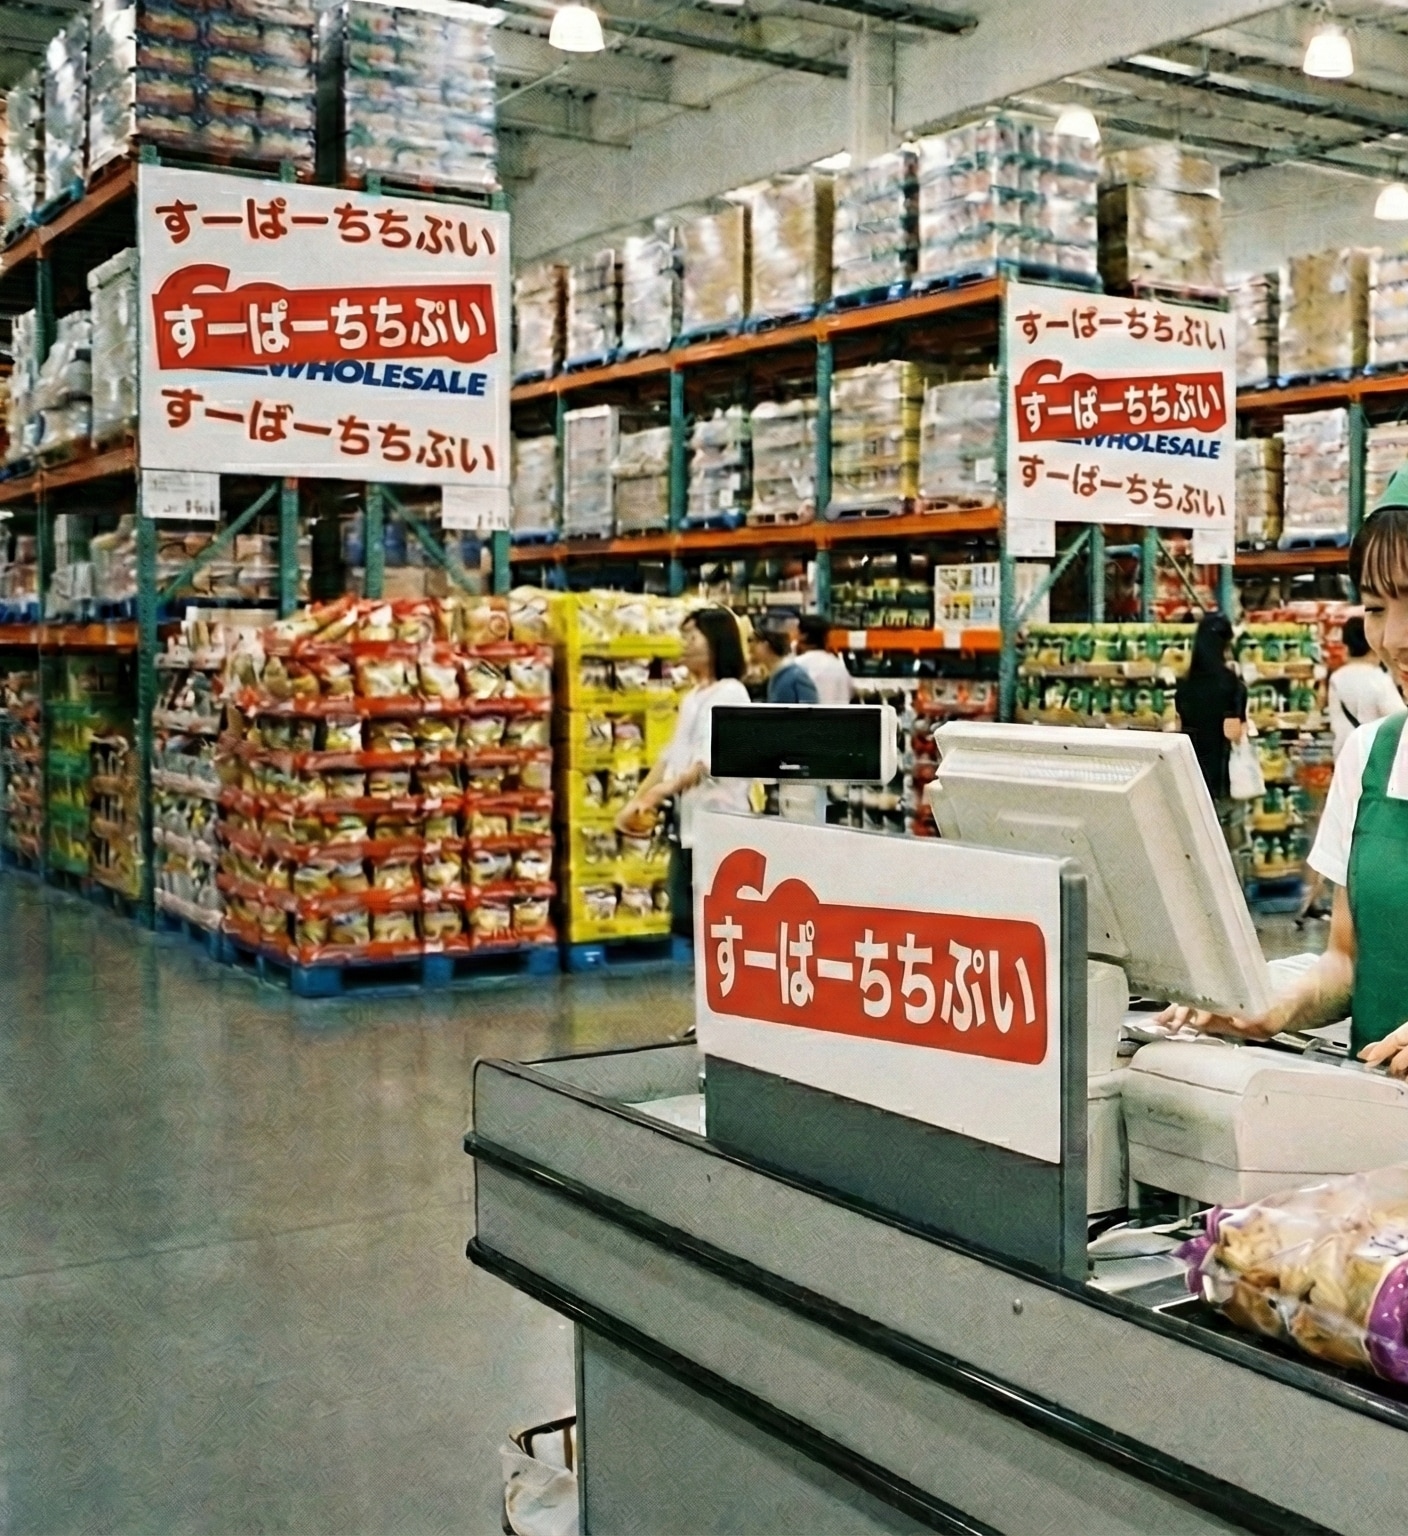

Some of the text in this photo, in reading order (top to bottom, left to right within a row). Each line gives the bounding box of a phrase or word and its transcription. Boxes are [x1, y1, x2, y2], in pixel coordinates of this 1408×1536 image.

[164, 297, 487, 358] すーぱーちちぷい
[710, 915, 1036, 1034] すーぱーちちぷい
